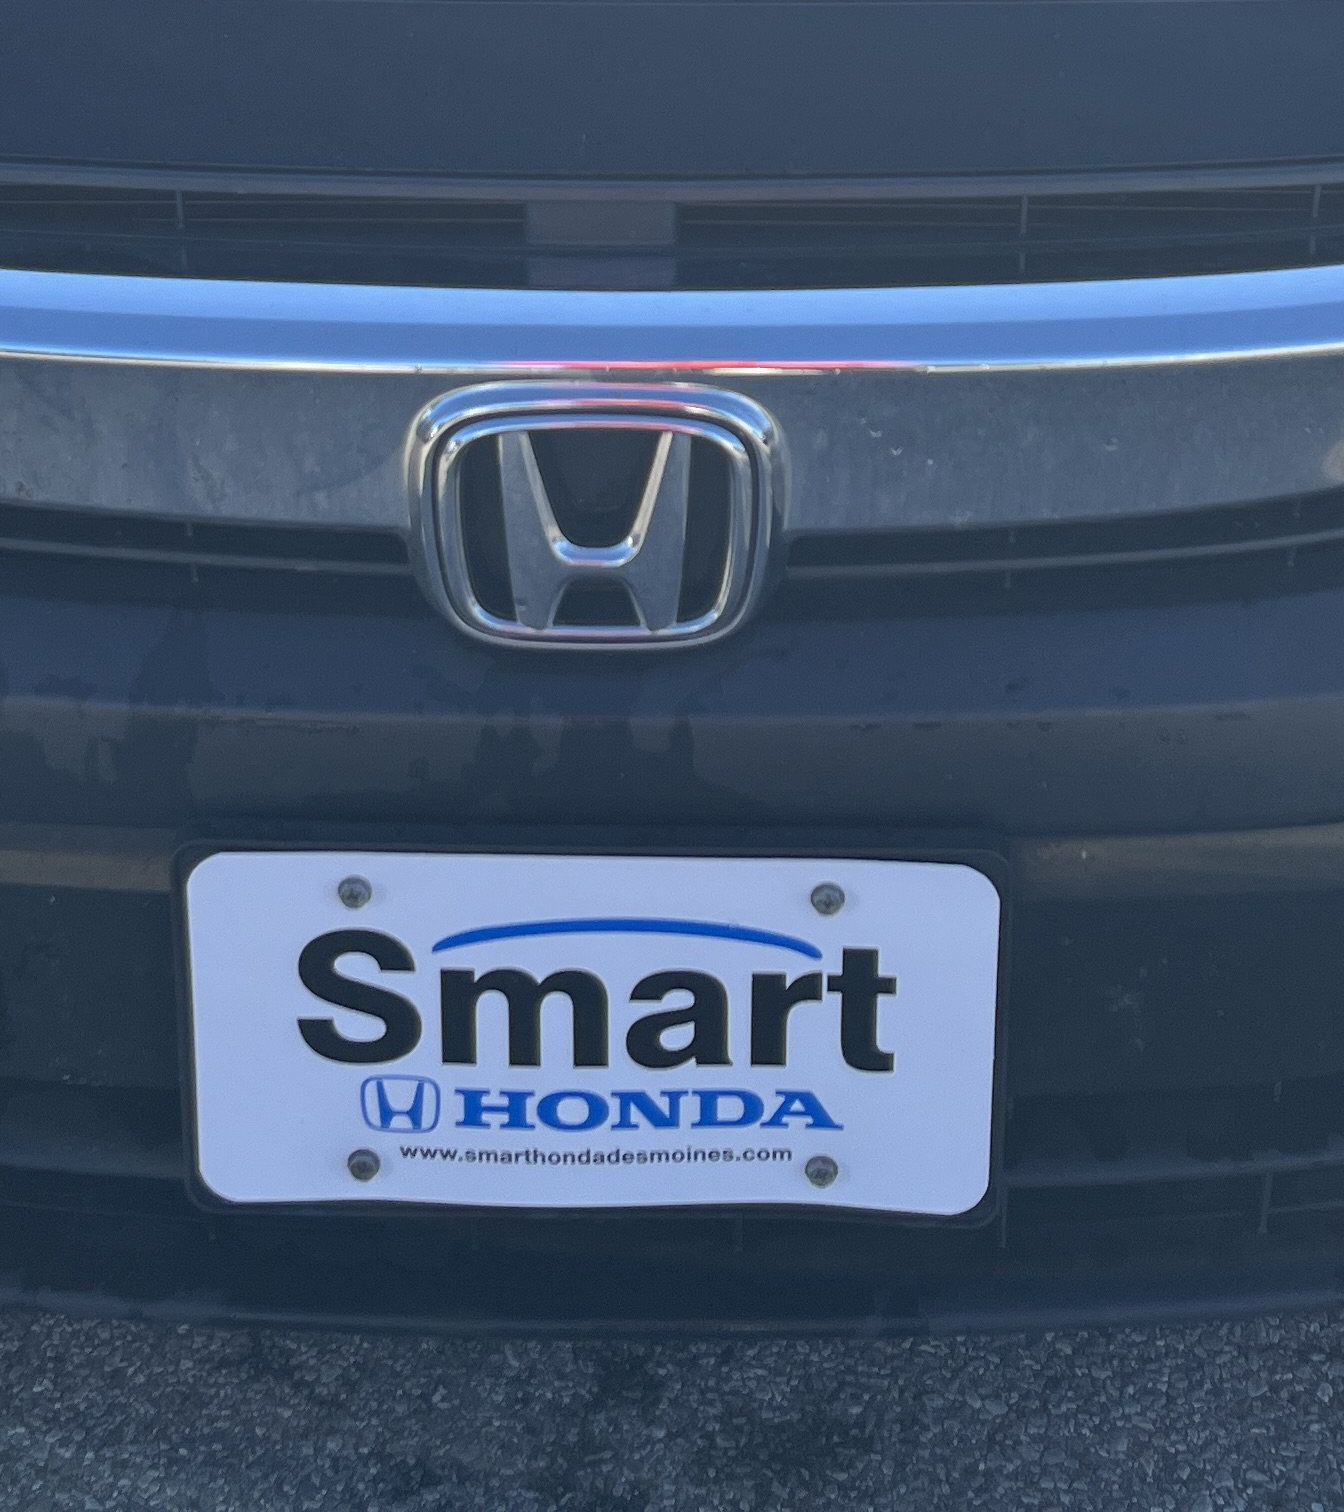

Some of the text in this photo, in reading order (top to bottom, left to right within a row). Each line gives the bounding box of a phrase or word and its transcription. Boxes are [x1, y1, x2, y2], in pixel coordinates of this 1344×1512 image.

[296, 928, 897, 1073] Smart
[455, 1088, 844, 1131] HONDA
[399, 1143, 794, 1166] www.smarthondadesmoines.com
